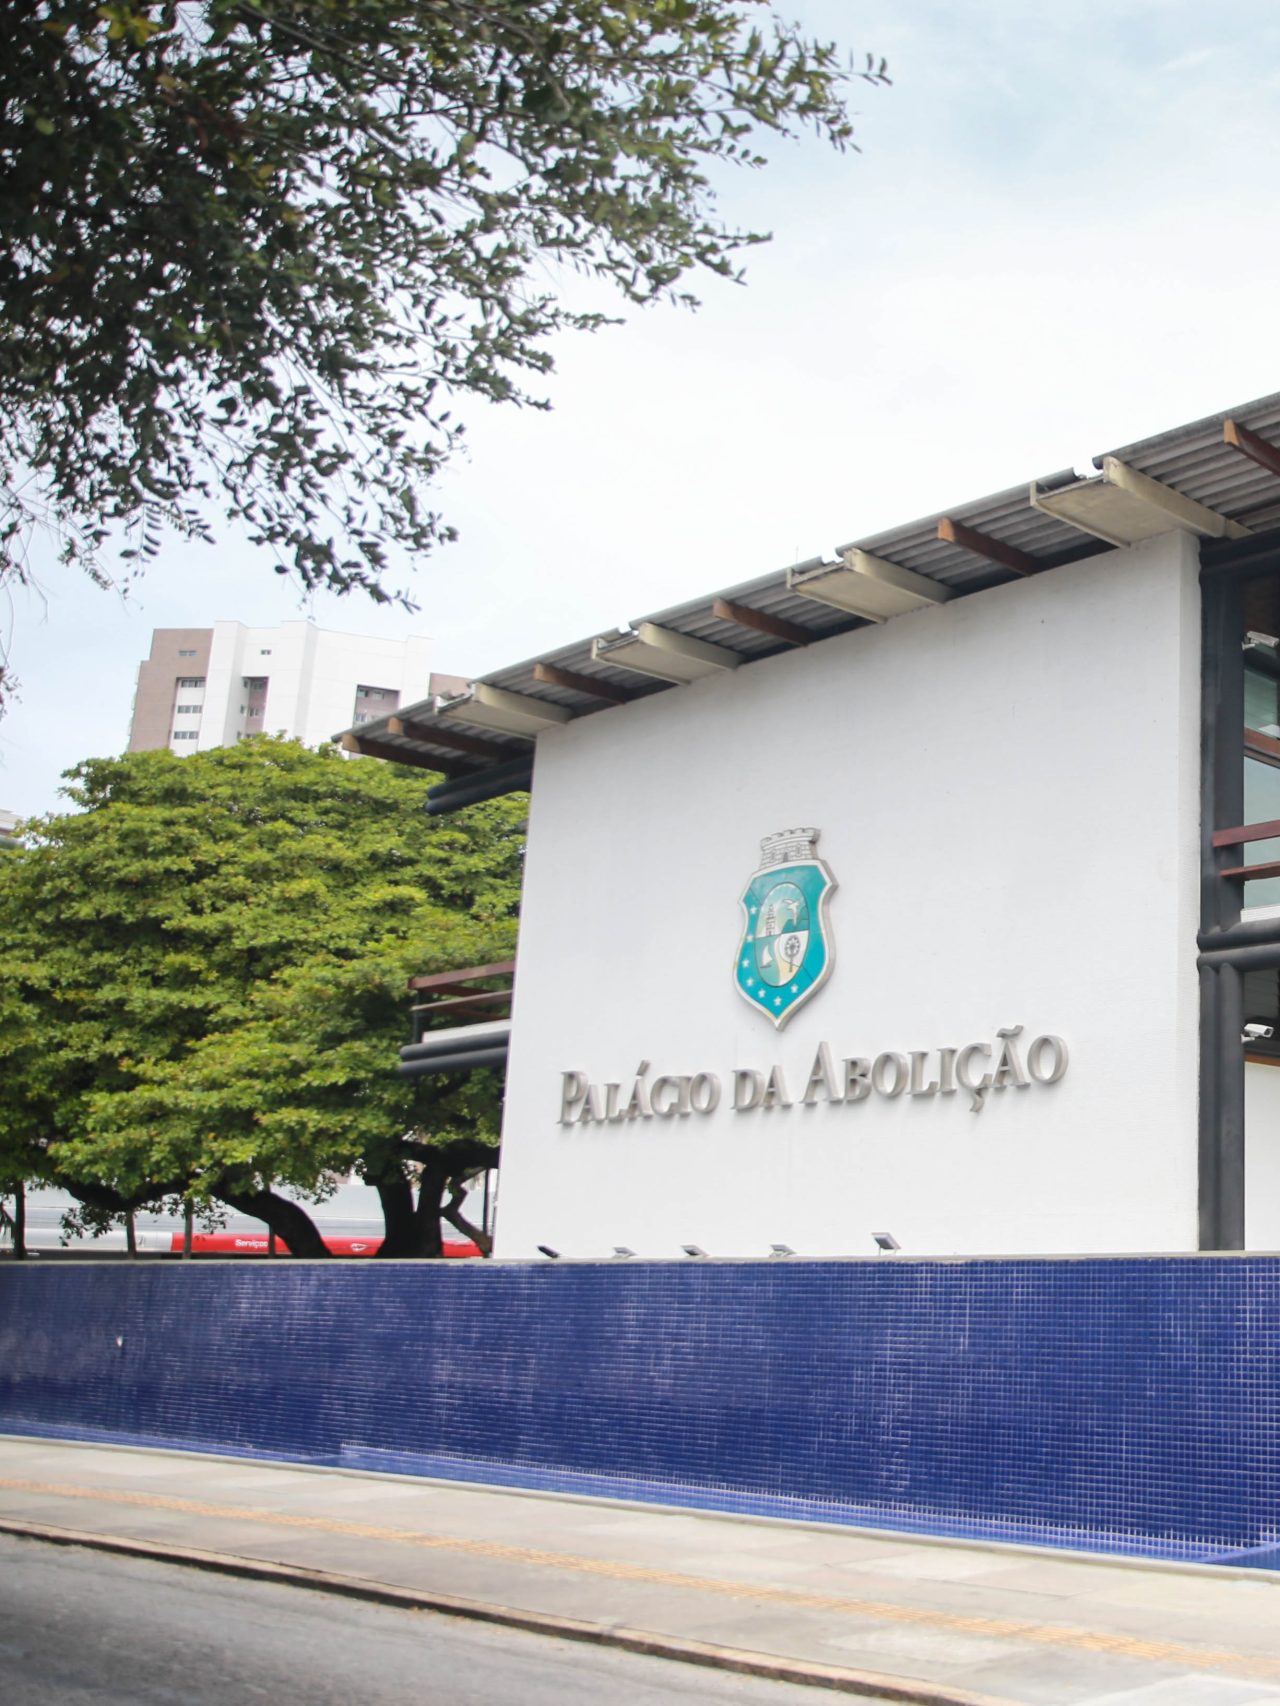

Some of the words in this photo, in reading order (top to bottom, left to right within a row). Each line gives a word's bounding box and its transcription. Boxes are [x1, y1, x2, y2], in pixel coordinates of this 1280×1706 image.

[557, 1059, 722, 1125] PALÁCIO
[731, 1064, 793, 1112] DA
[799, 1024, 1070, 1113] ABOLIÇÃO
